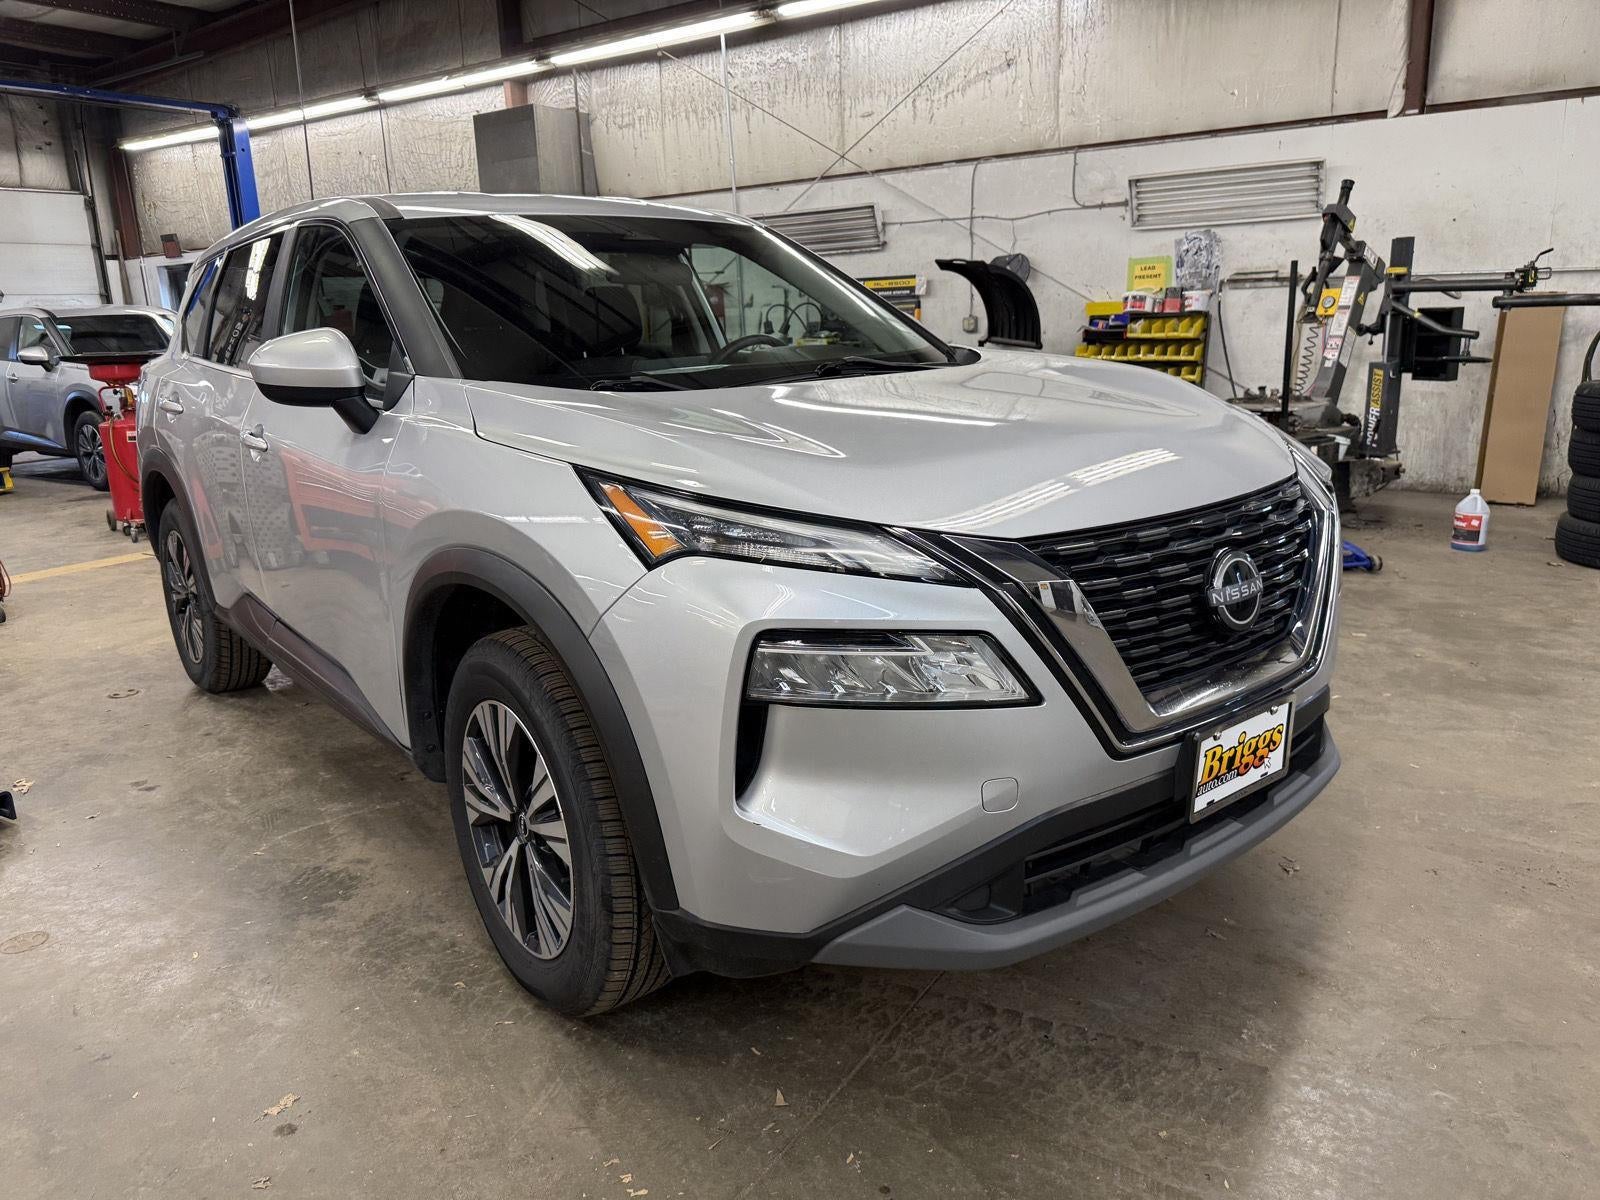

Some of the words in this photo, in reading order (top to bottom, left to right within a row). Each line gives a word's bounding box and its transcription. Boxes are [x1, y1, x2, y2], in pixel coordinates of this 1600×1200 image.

[1212, 580, 1263, 604] NISSAN
[1198, 723, 1284, 786] Briggs
[1197, 769, 1237, 797] auto.com
